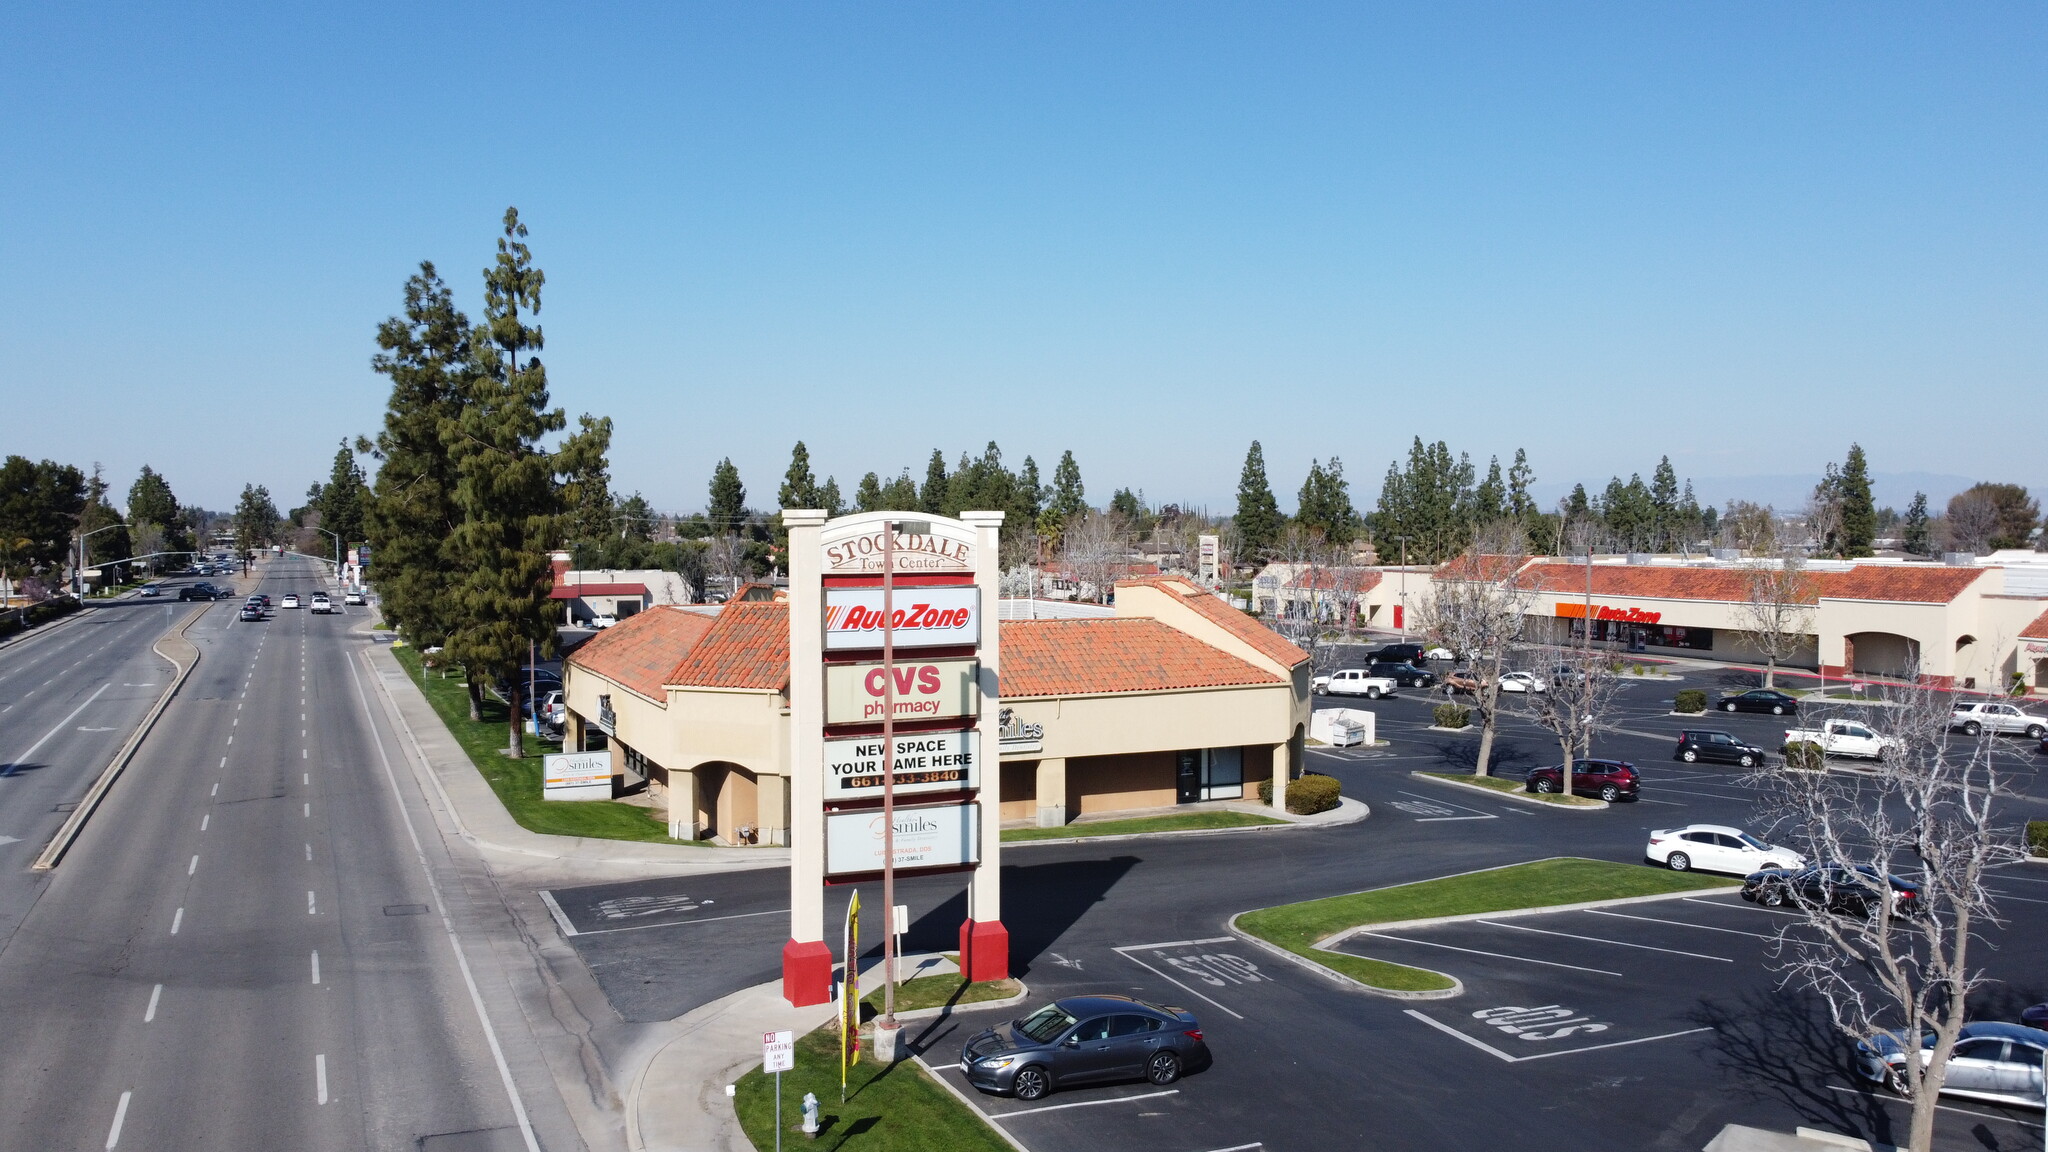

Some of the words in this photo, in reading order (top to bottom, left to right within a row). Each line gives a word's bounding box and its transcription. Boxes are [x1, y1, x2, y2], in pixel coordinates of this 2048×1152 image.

[827, 533, 970, 566] STOCKDALE
[860, 557, 894, 570] Tow
[900, 556, 945, 569] Center
[1597, 605, 1662, 625] AutoZone
[864, 665, 941, 697] CVS
[864, 700, 941, 719] phrmacy
[896, 739, 947, 755] SPACE
[568, 757, 604, 770] smiles
[831, 760, 877, 776] YOUR
[882, 756, 927, 771] AME
[932, 752, 973, 767] HERE
[850, 769, 960, 788] 661-33-3840
[891, 816, 938, 834] smiles
[892, 847, 918, 855] STRADA,
[1165, 952, 1275, 987] STOP
[765, 1033, 775, 1042] NO
[766, 1042, 792, 1052] PARKING
[773, 1060, 786, 1068] TIME
